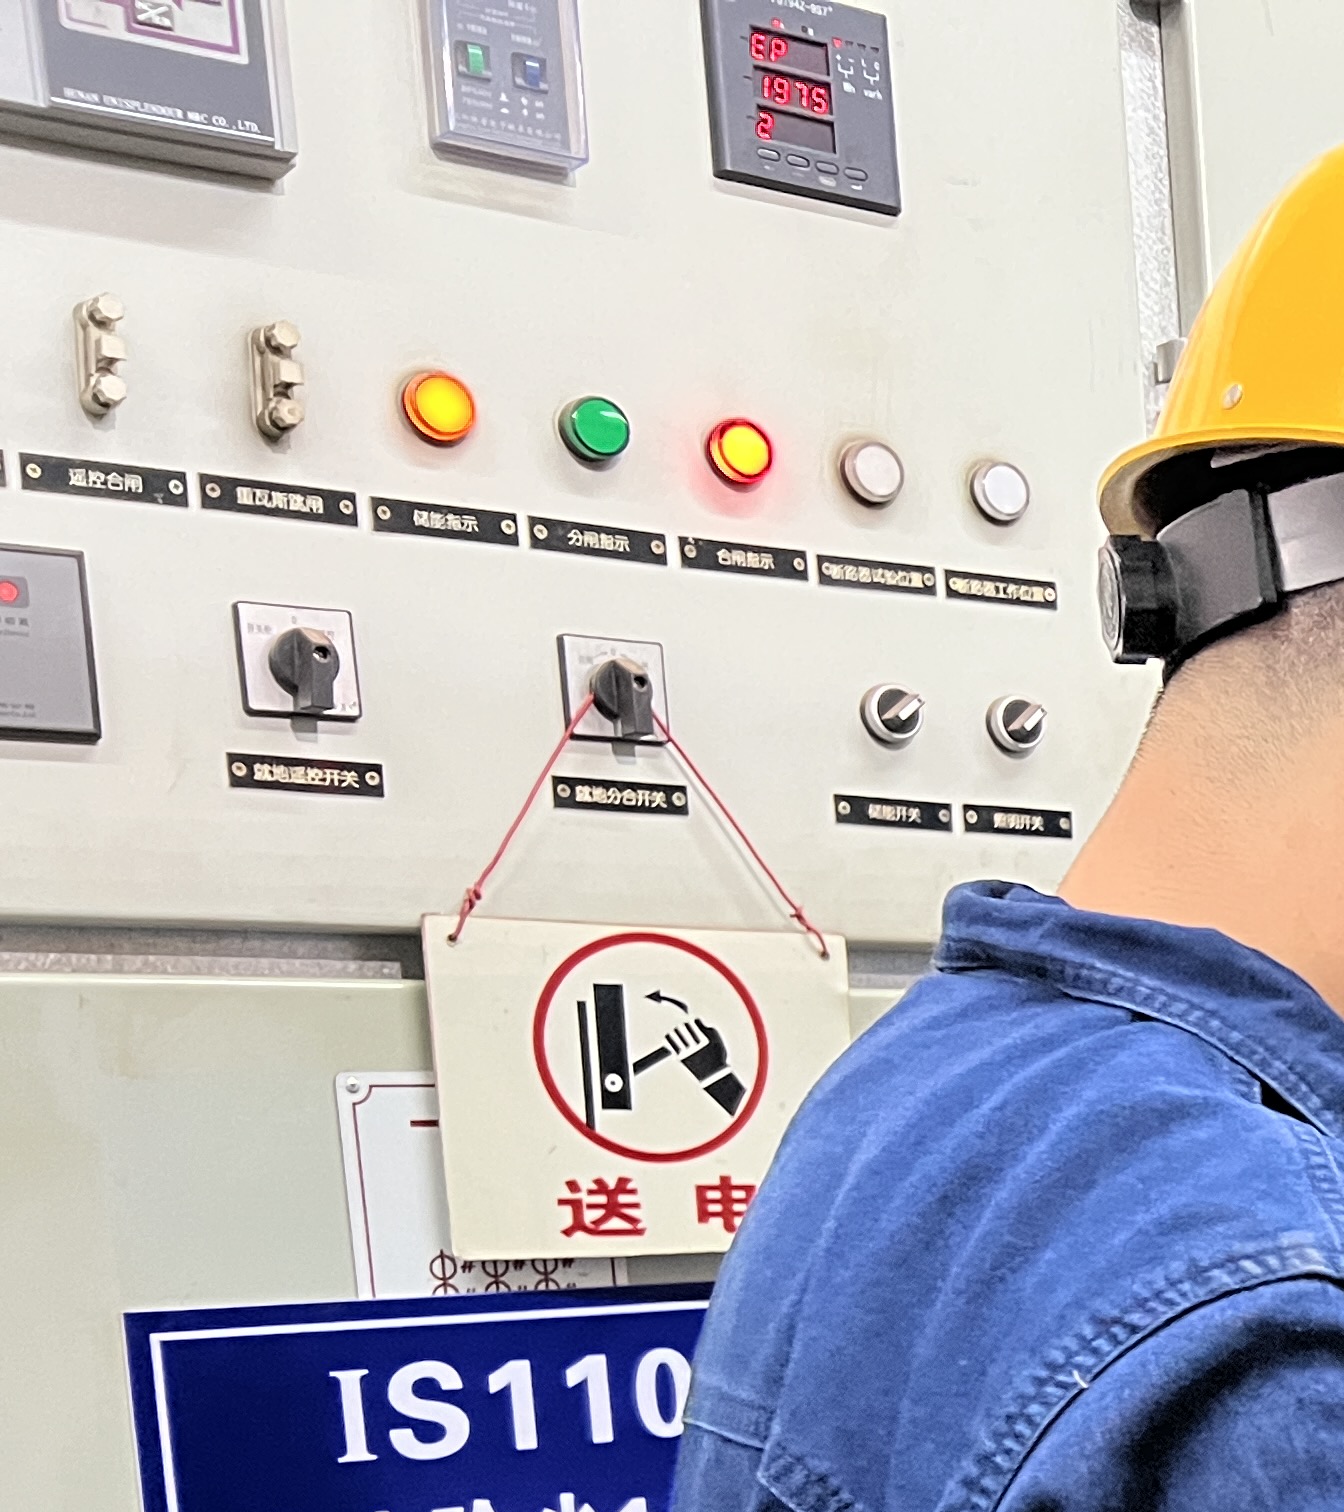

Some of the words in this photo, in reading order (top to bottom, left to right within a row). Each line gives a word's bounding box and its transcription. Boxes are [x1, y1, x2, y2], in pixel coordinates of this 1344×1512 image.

[756, 111, 774, 140] 2
[568, 529, 631, 553] 分闸指示
[716, 548, 776, 571] 合闸指示
[253, 763, 360, 789] 就地遥控开关
[575, 785, 668, 809] 就地分合开关
[557, 1175, 757, 1238] 送电
[329, 1347, 692, 1464] IS110
